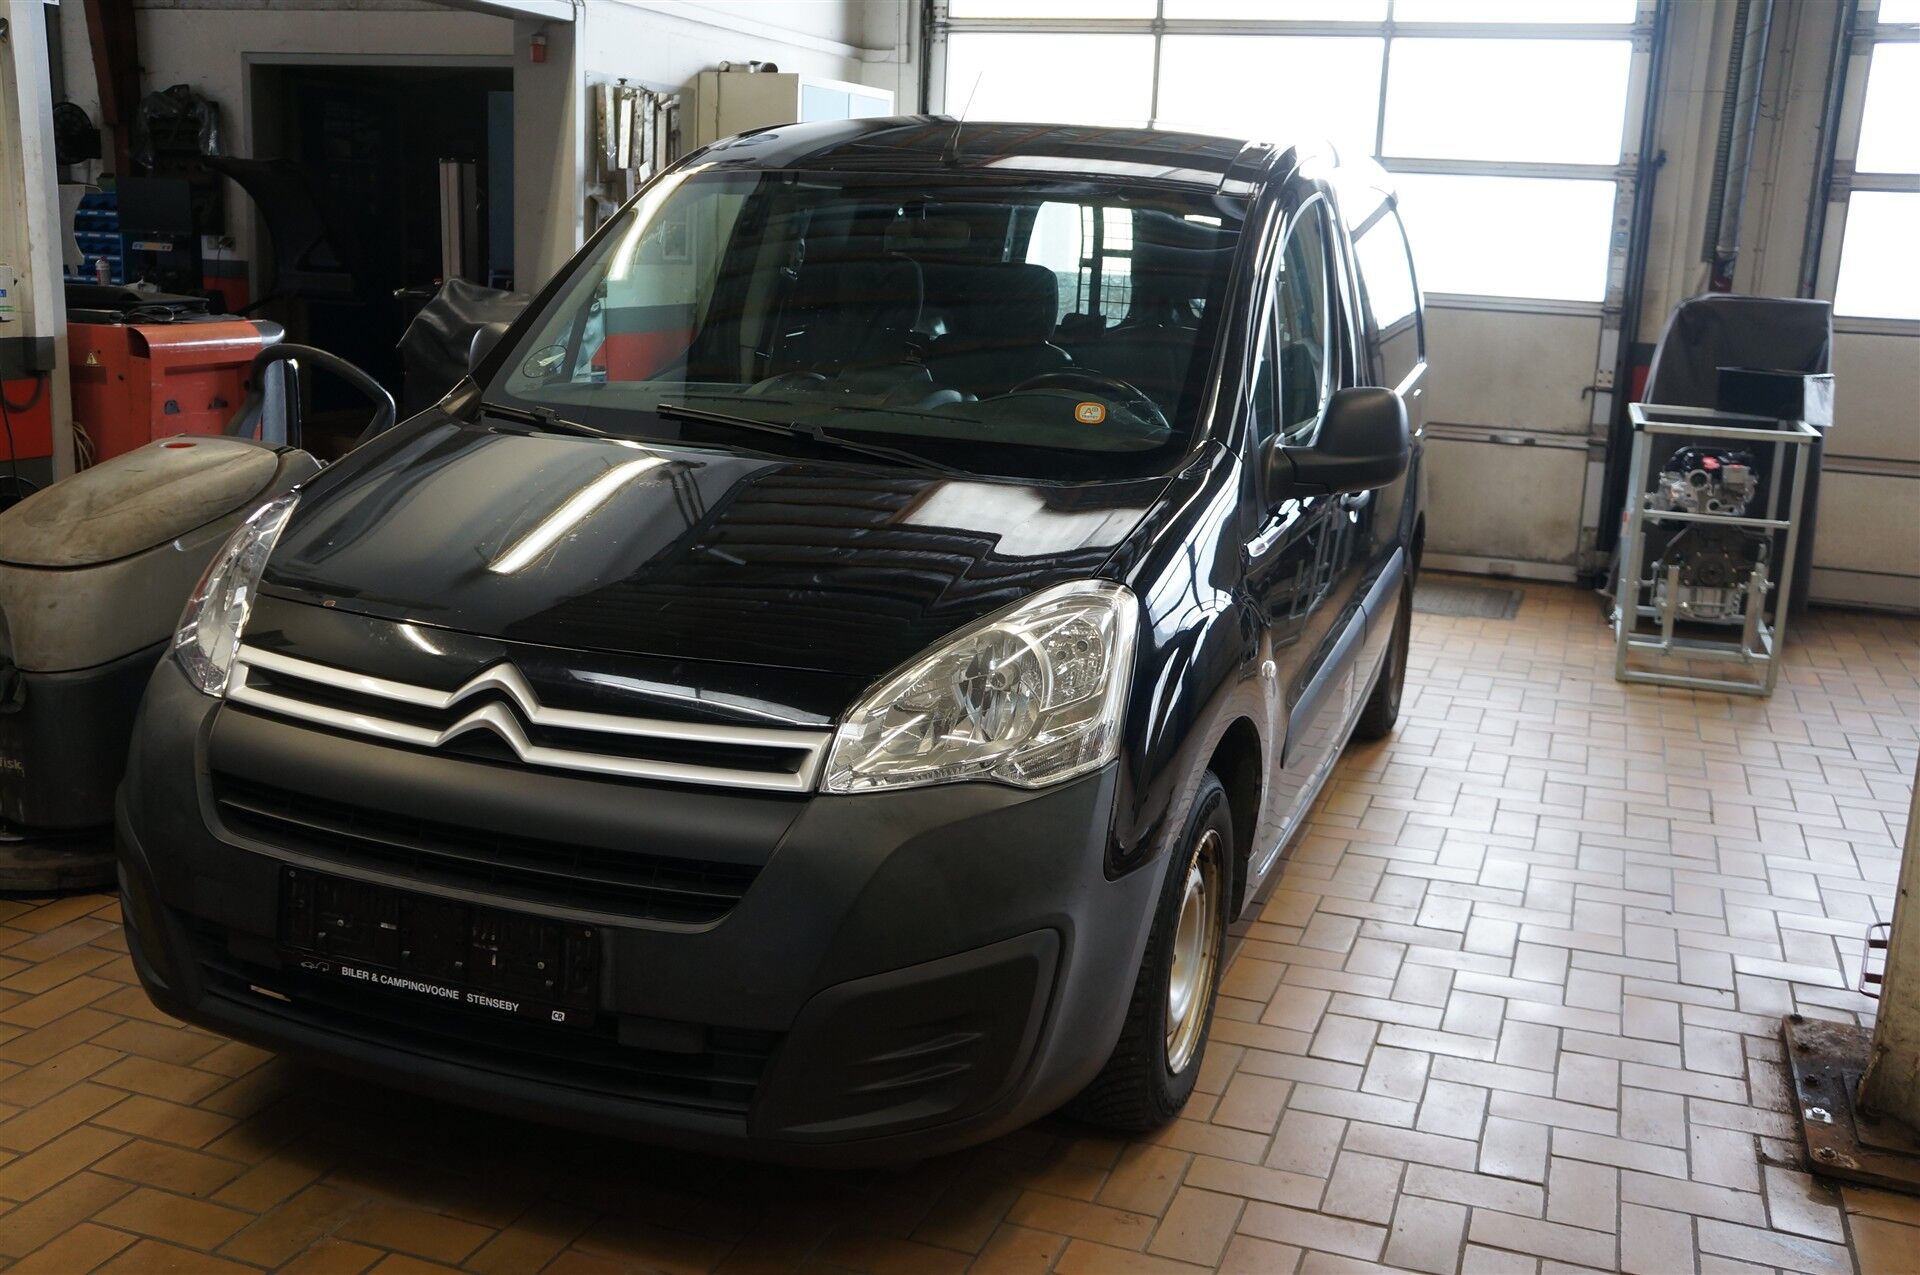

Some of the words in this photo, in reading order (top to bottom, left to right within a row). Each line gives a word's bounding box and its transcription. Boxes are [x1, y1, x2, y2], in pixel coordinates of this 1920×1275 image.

[341, 966, 370, 981] BILER
[371, 973, 379, 983] &
[380, 975, 460, 1000] CAMPINGVOGNE
[466, 993, 520, 1012] STENSEBY
